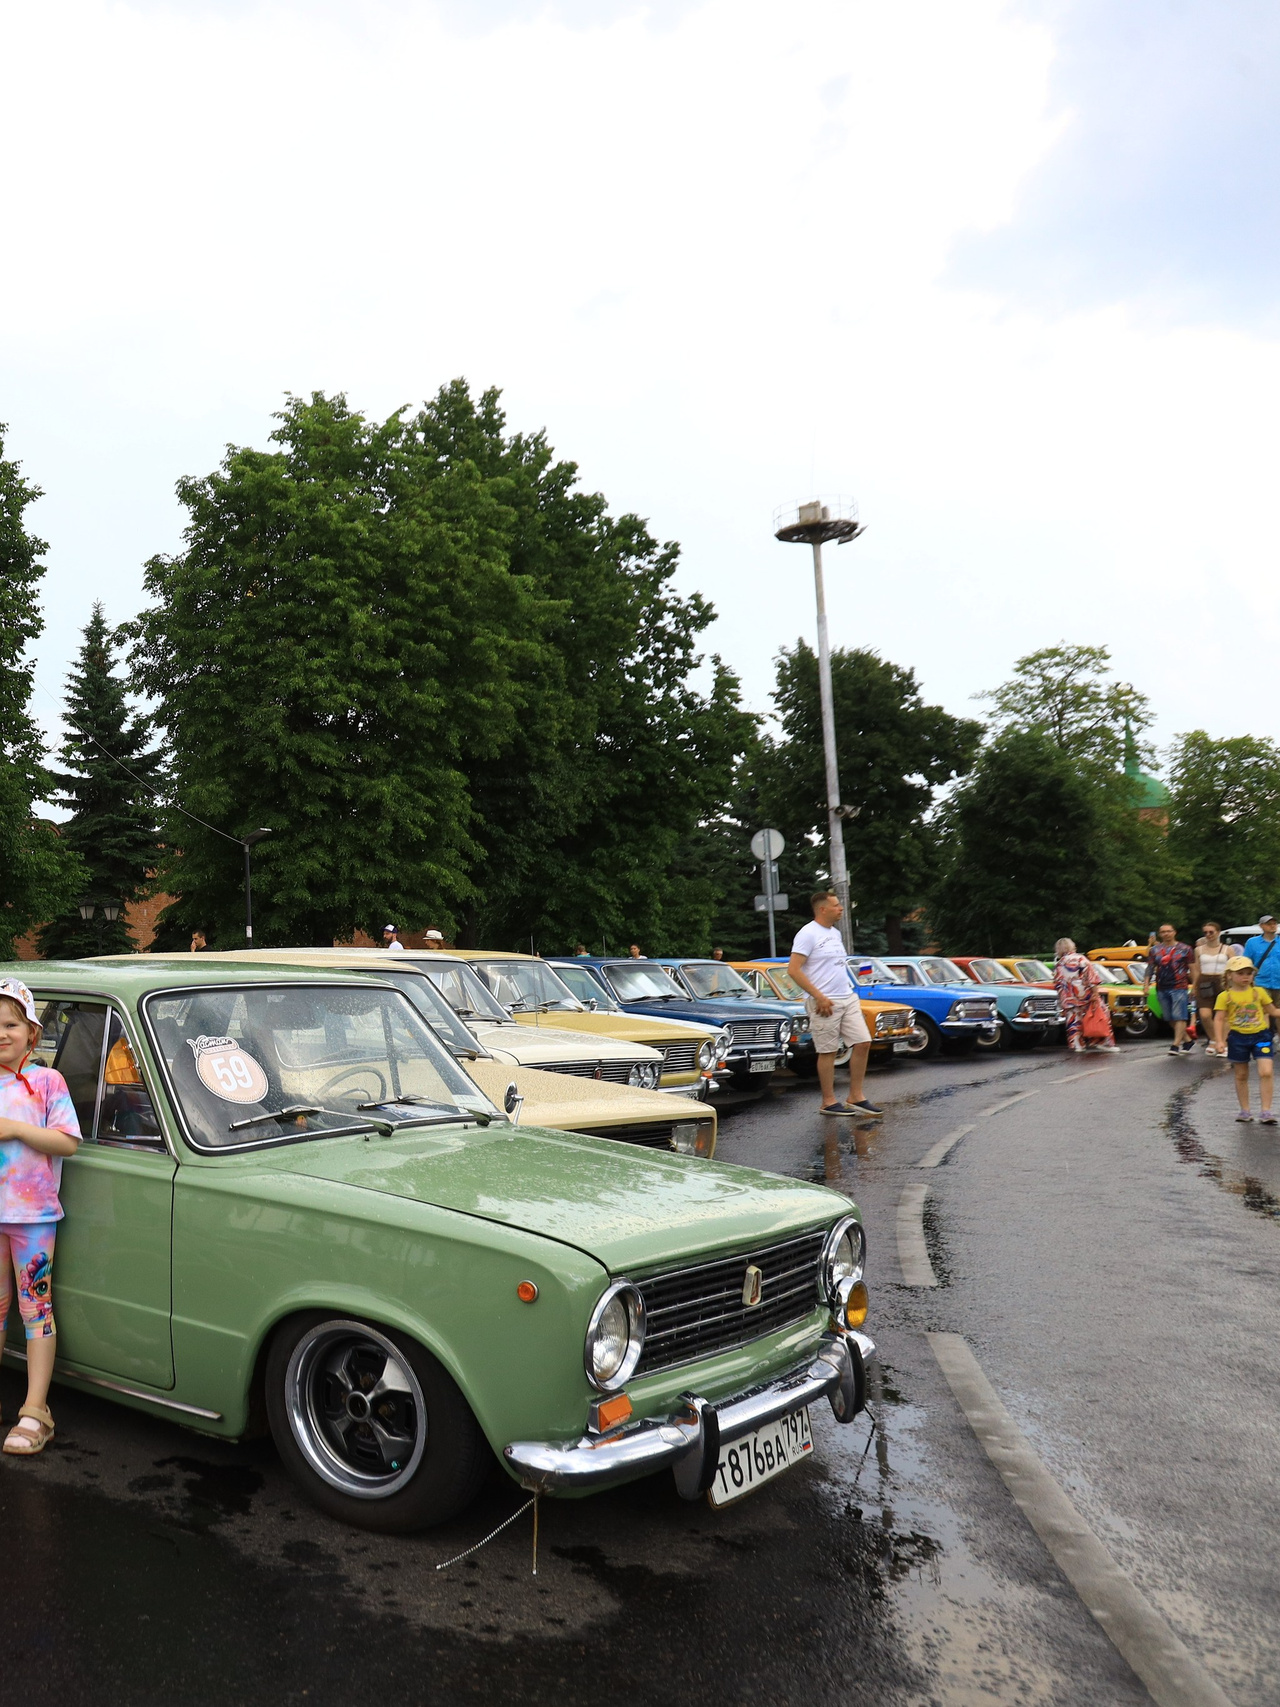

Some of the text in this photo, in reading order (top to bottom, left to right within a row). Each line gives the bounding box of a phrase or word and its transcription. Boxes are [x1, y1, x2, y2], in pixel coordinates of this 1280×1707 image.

[211, 1056, 253, 1092] 59
[717, 1410, 805, 1494] Т876ВА 797
[792, 1442, 803, 1456] RUS
